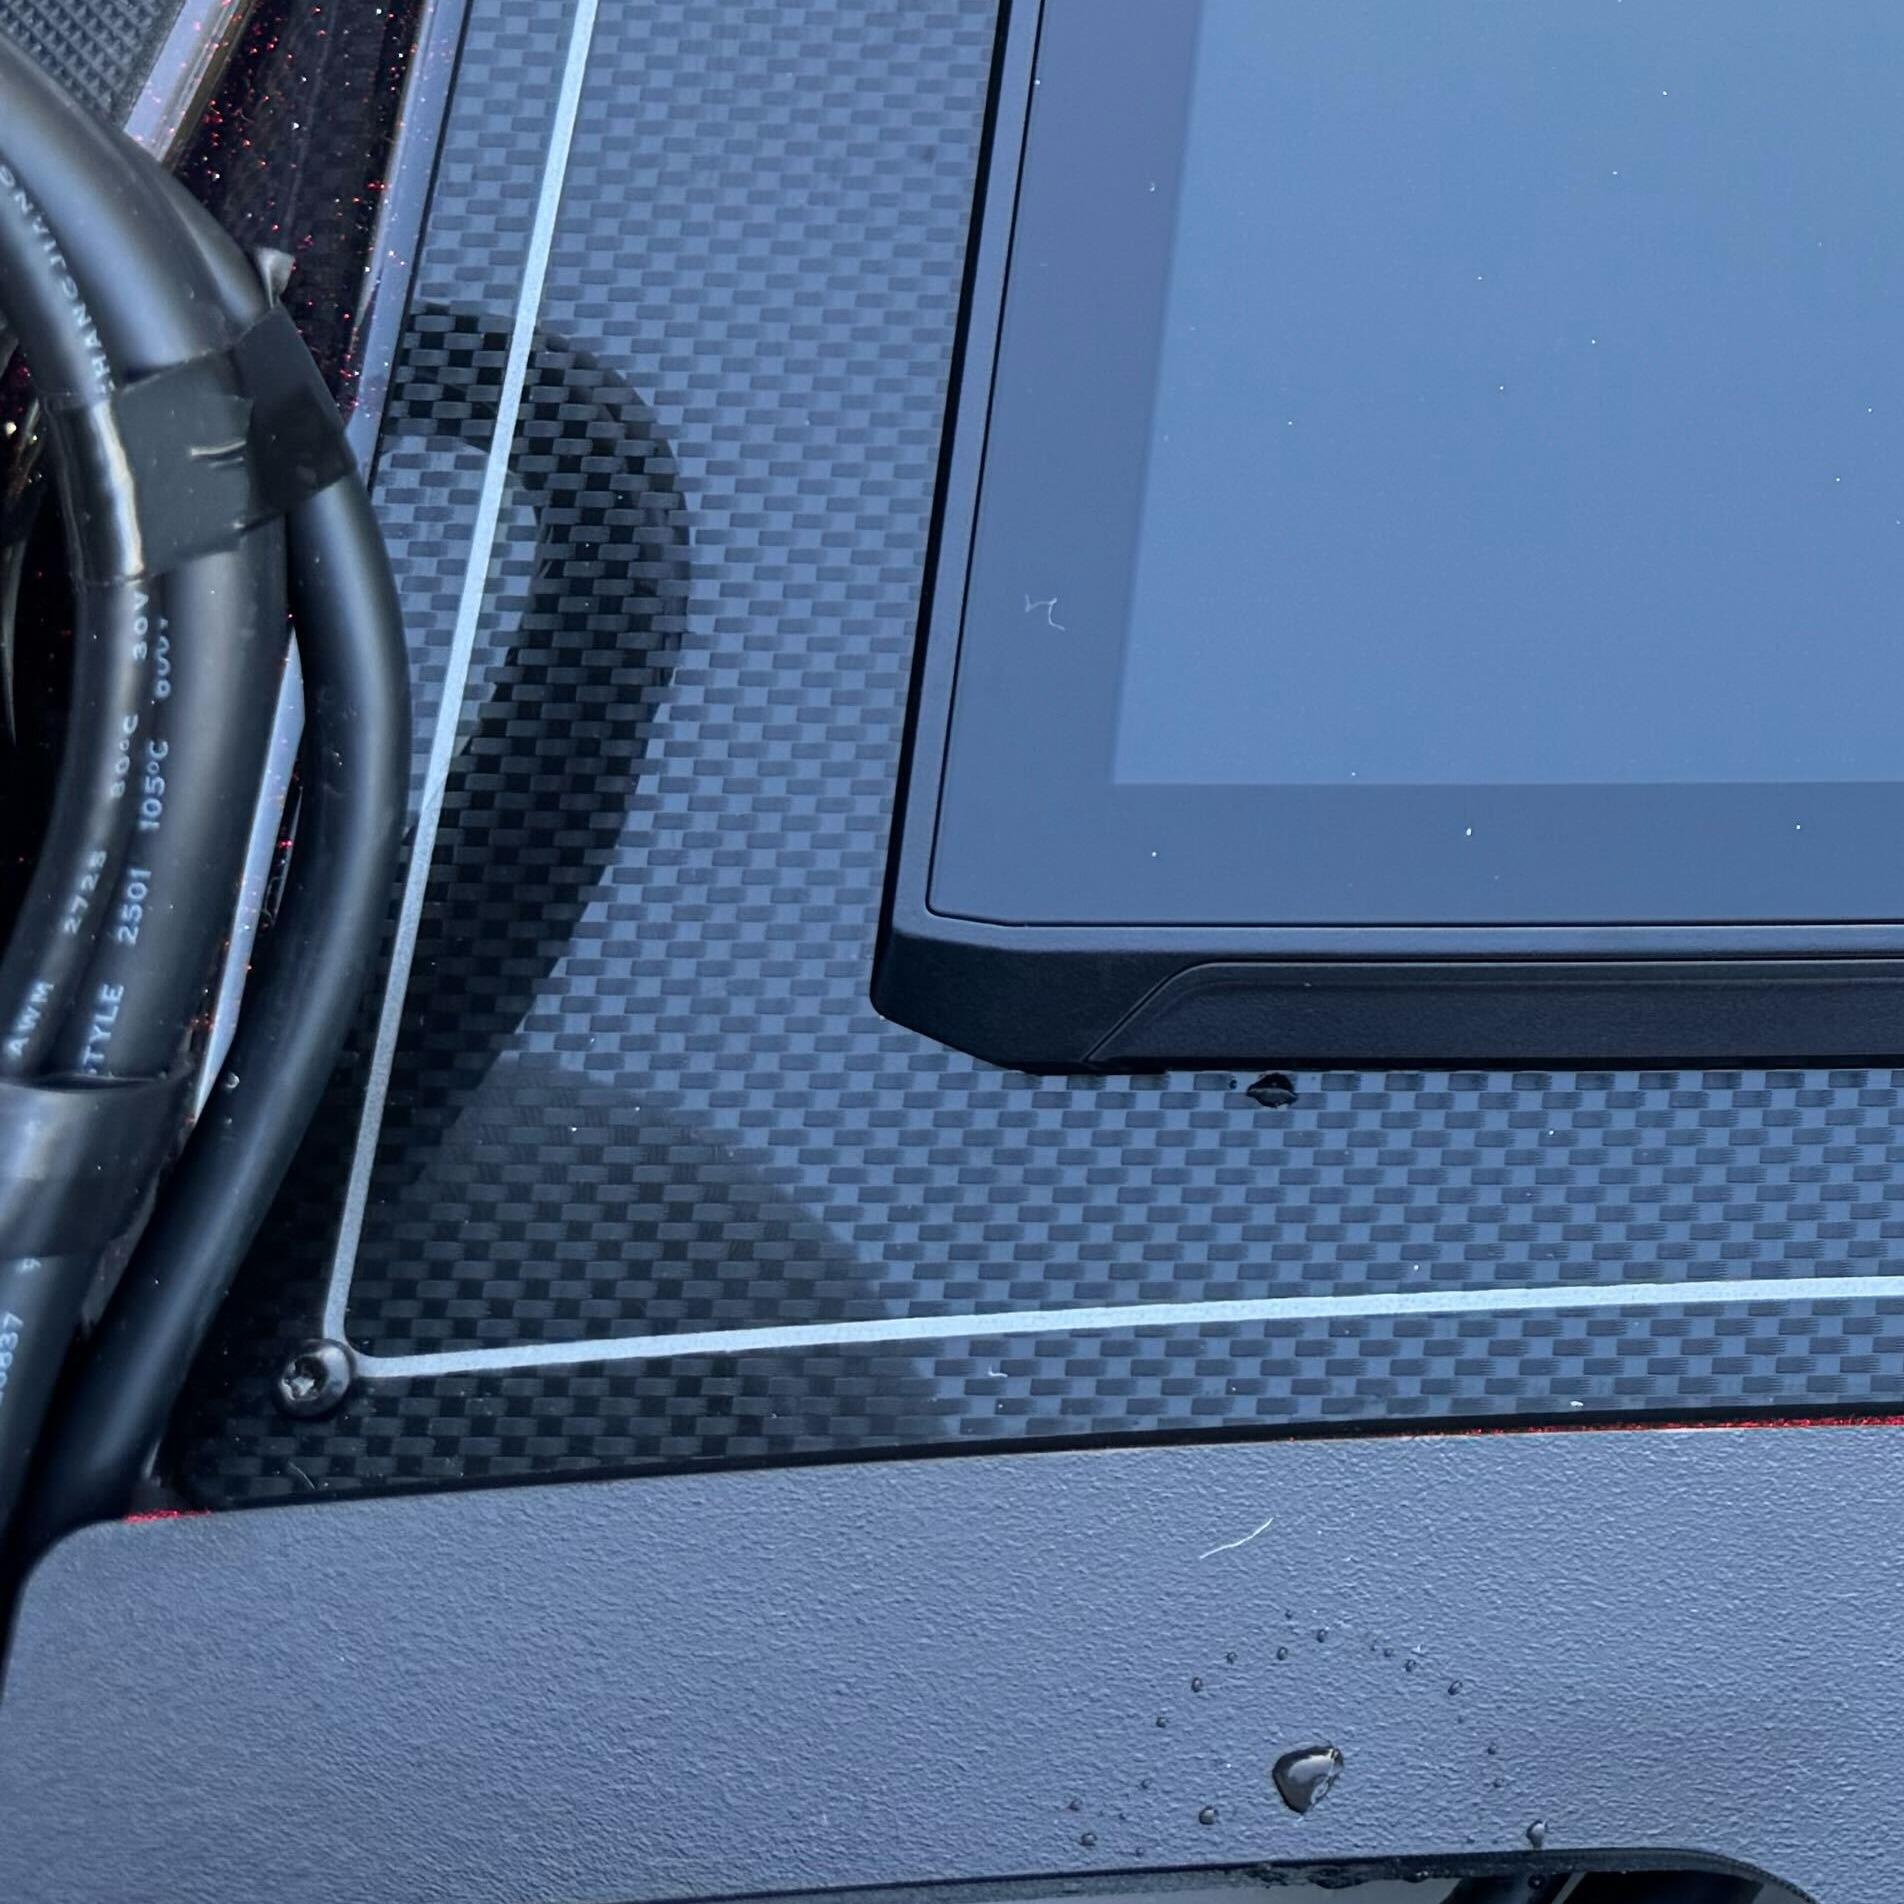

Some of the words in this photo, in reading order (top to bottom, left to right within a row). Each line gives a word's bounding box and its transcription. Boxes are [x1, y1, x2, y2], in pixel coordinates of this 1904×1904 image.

[7, 980, 54, 1057] AWM
[133, 590, 149, 660] 30V
[117, 867, 152, 946] 2501
